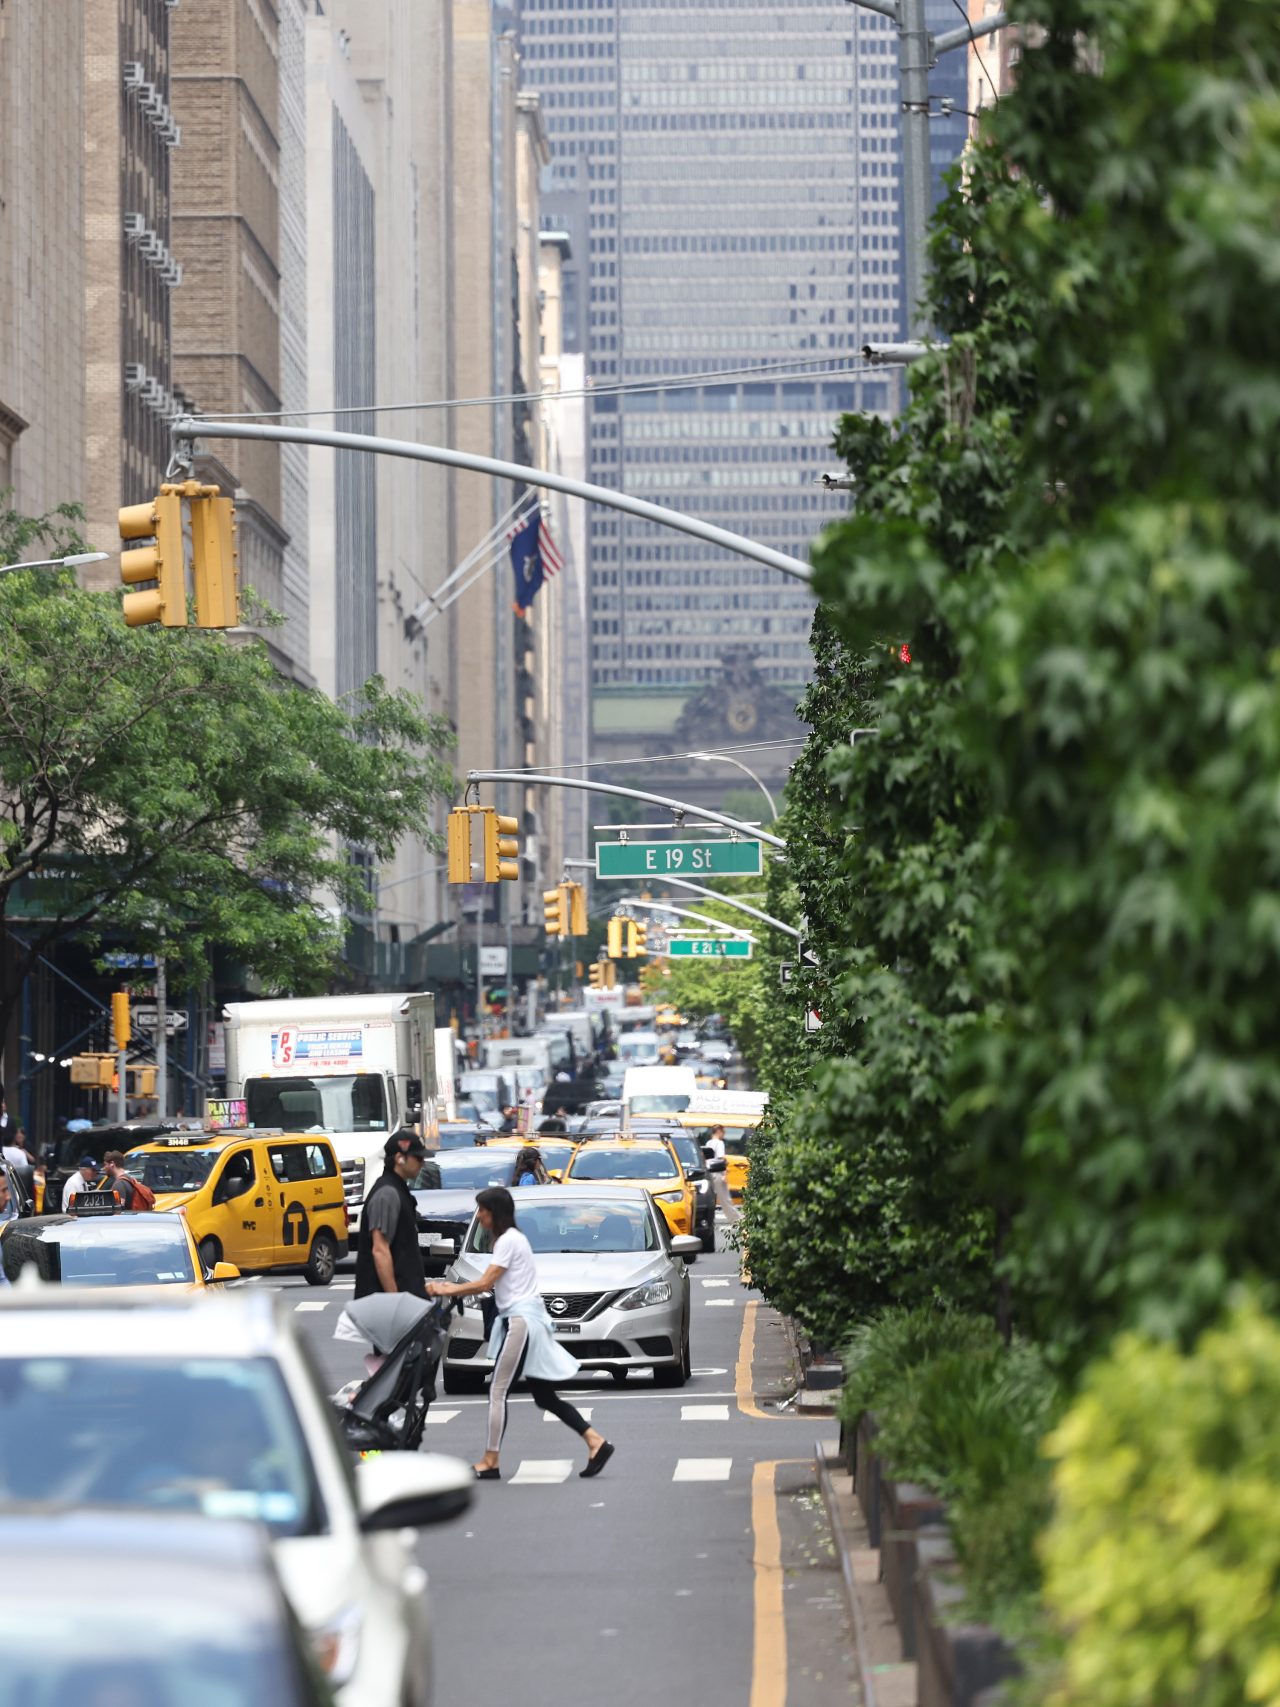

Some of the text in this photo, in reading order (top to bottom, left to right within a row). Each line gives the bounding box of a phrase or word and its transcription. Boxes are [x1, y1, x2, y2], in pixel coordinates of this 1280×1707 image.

[646, 848, 712, 870] E 19 St
[691, 942, 700, 953] E
[281, 1032, 289, 1048] P
[327, 1030, 362, 1041] SERVICE
[283, 1047, 291, 1062] S
[208, 1101, 230, 1115] PLAY
[83, 1194, 105, 1207] 2J21
[242, 1220, 257, 1231] NYC
